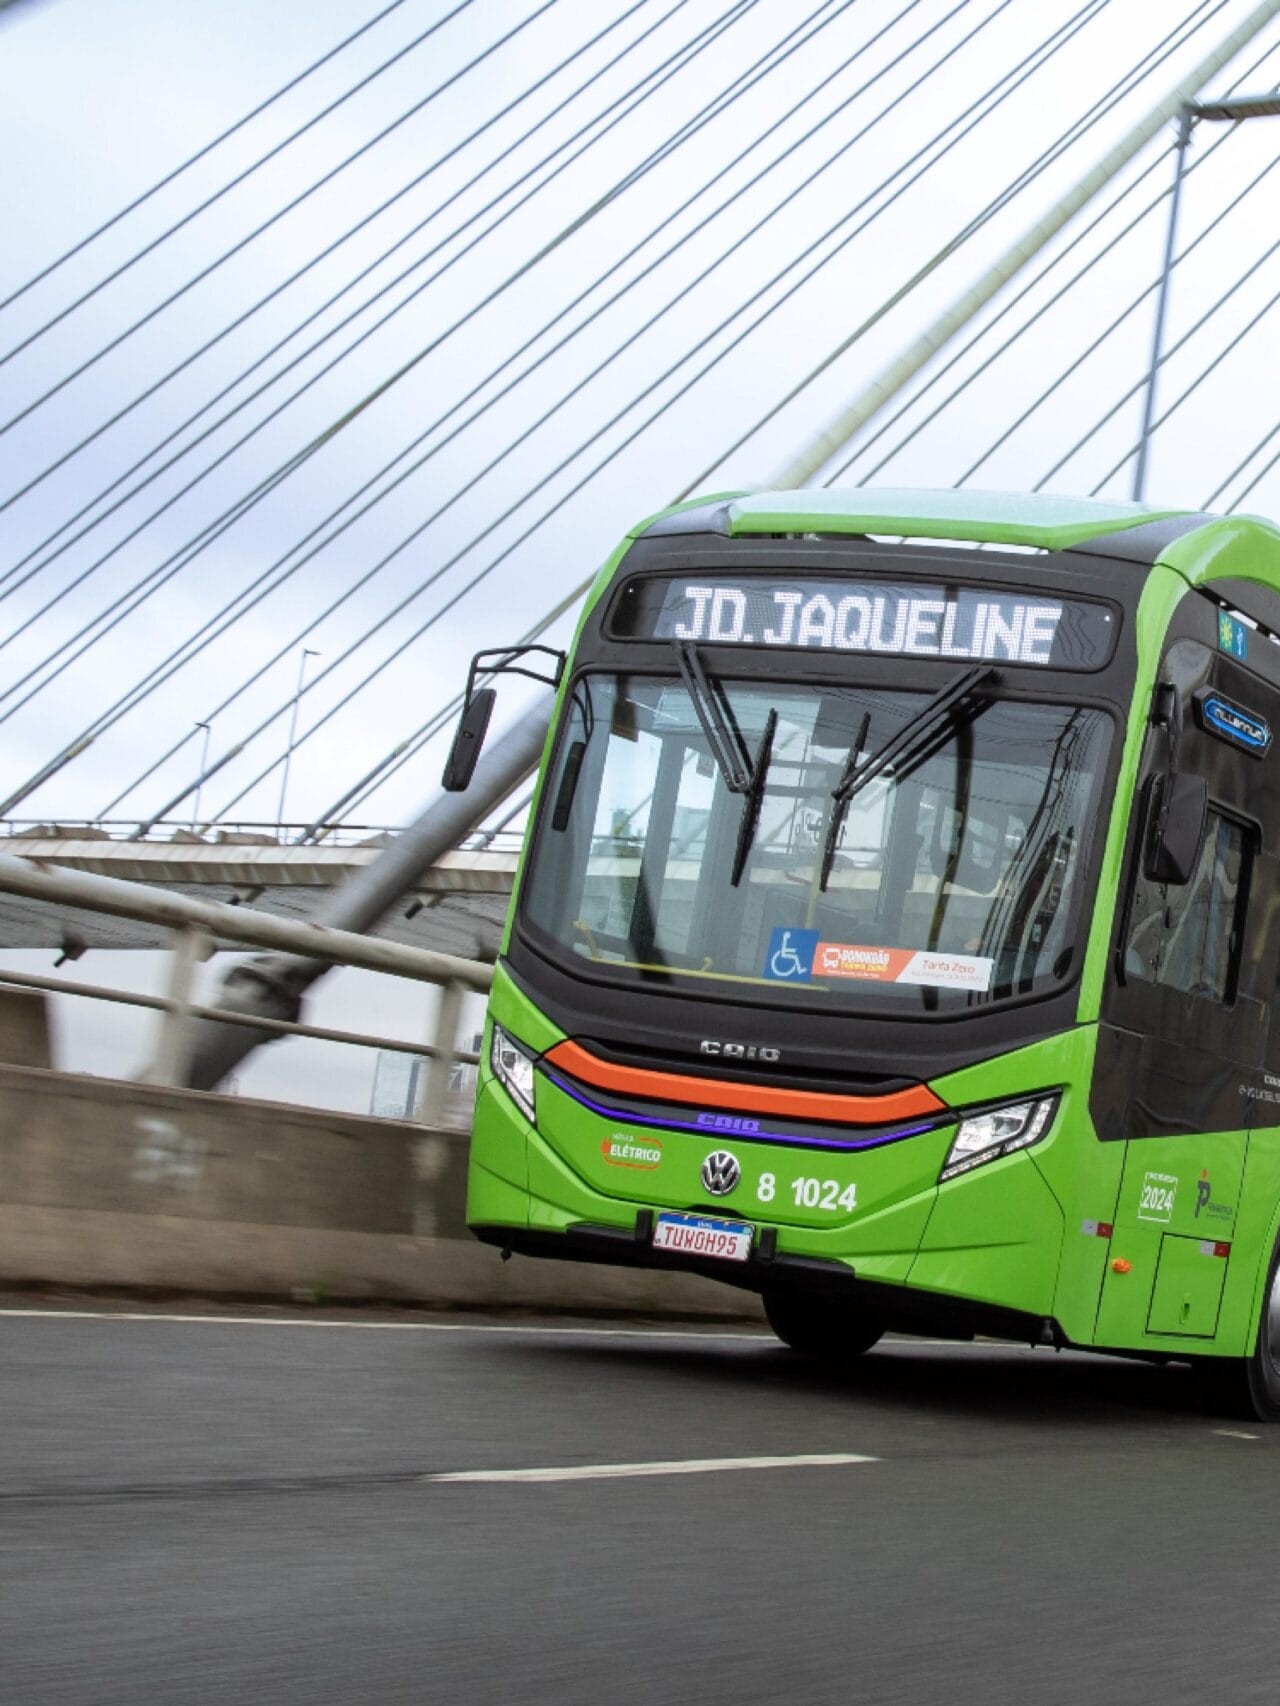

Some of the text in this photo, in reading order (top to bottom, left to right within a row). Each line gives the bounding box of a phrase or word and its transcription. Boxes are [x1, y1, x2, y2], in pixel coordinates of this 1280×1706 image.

[675, 586, 1062, 664] JD. JAQUELINE
[701, 1040, 780, 1062] CAIO
[610, 1144, 661, 1162] ELÉTRICO
[757, 1173, 857, 1212] 8 1024
[1141, 1185, 1173, 1212] 2024
